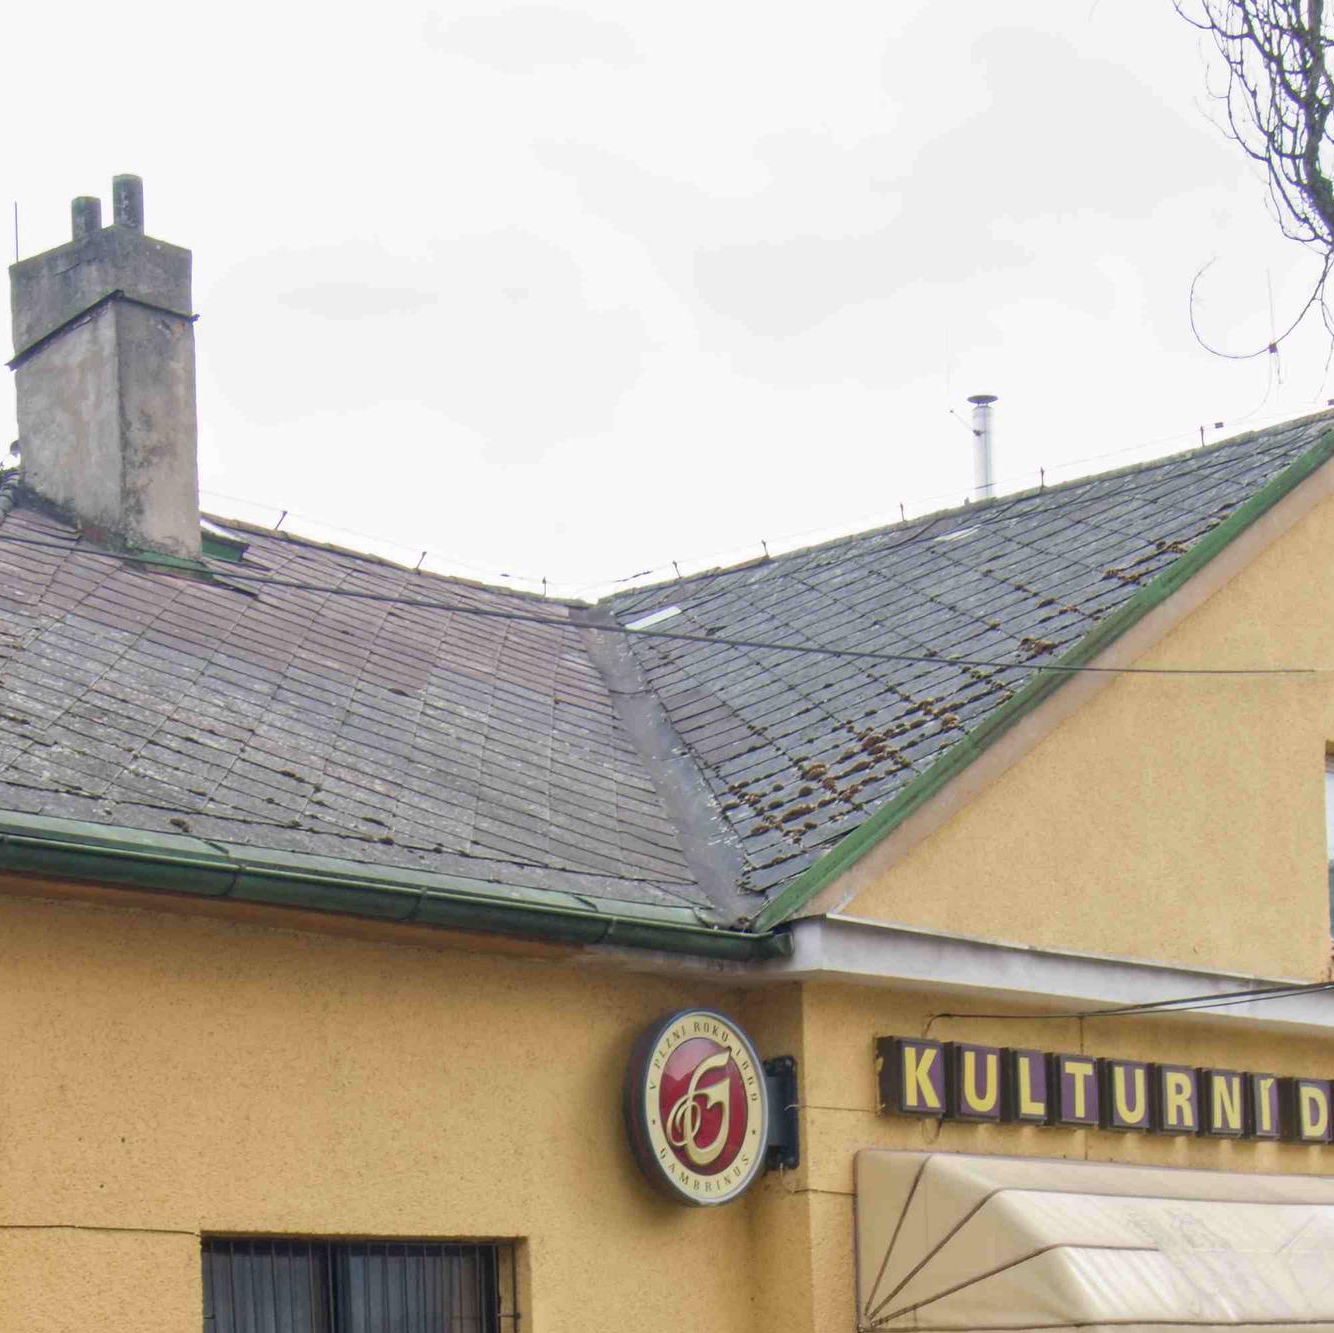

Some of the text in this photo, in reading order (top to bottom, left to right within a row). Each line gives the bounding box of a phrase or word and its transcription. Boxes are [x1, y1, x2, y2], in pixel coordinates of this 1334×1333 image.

[693, 1022, 729, 1042] ROKU
[903, 1046, 1274, 1132] KULTURNÍ
[660, 1147, 749, 1193] GAMBRINUS
